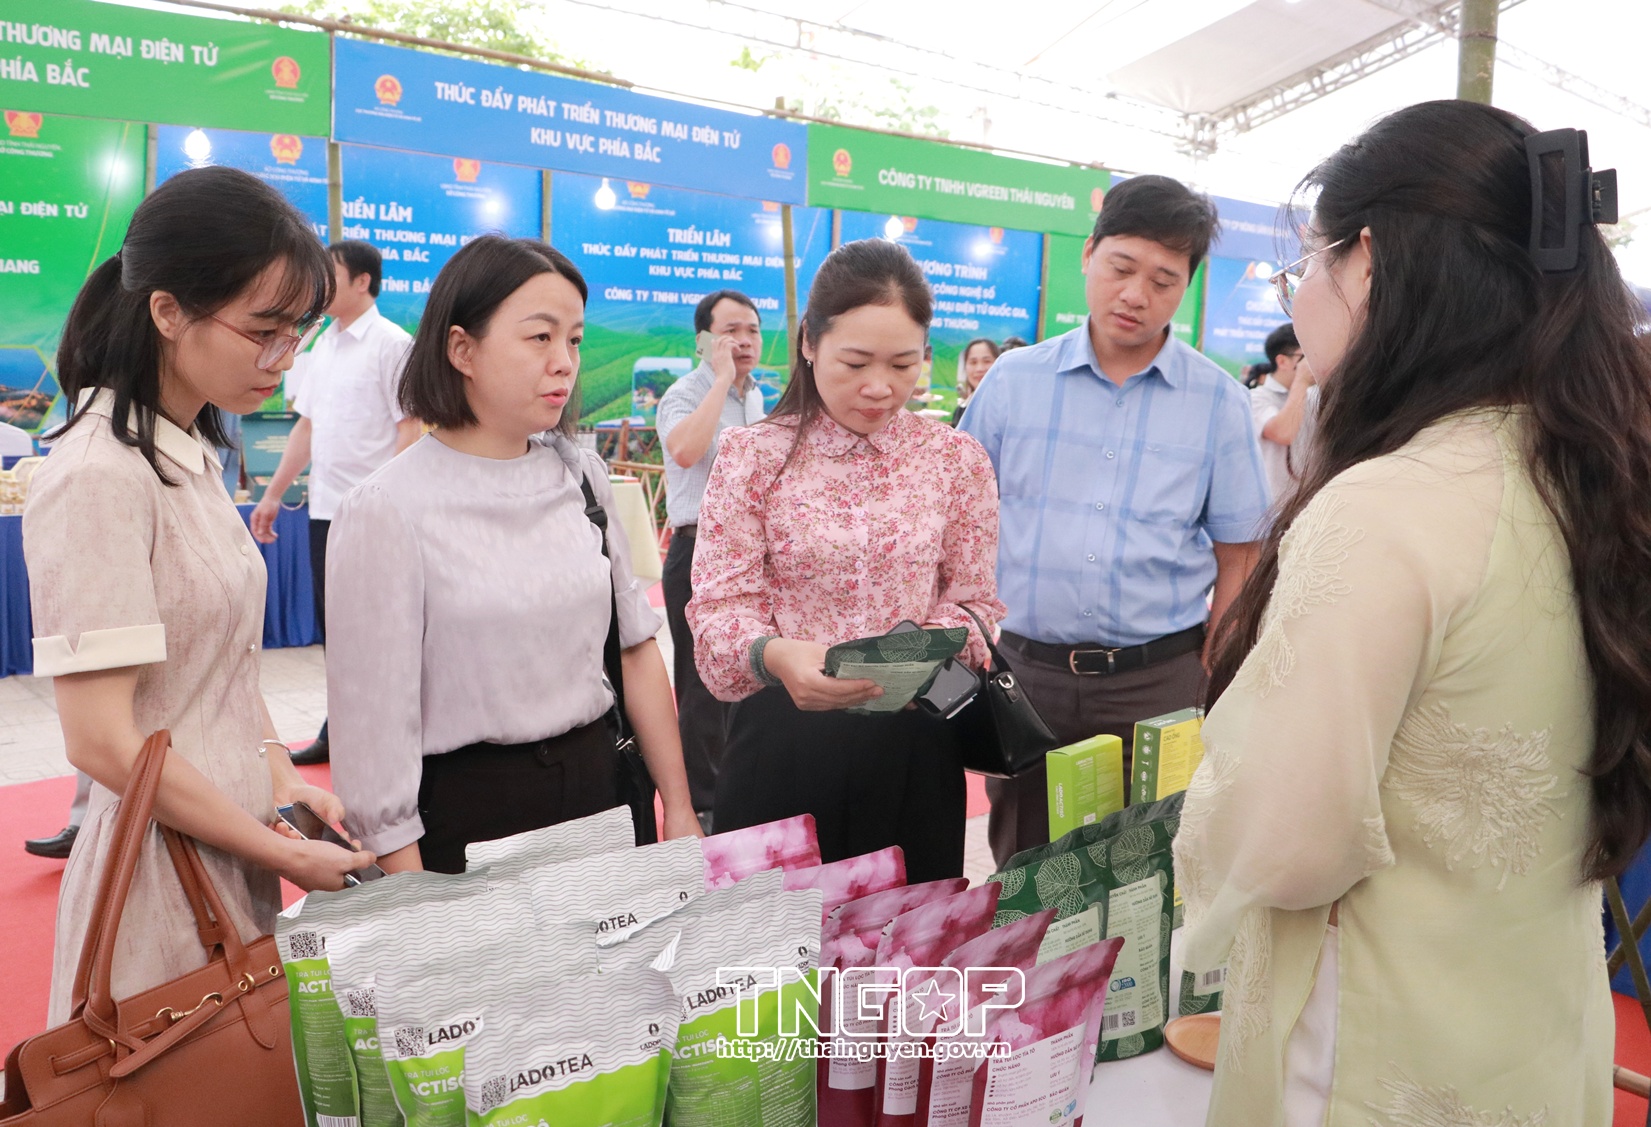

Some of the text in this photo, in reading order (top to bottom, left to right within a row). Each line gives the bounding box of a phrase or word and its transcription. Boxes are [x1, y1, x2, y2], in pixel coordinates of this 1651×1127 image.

[0, 20, 219, 67] THƯƠNG MẠI ĐIỆN TỬ
[0, 56, 90, 88] HÍA BẮC
[434, 82, 741, 150] THÚC ĐẨY PHÁT TRIỂN THƯƠNG MẠI ĐIỆN TỬ
[530, 127, 661, 163] KHU VỰC PHÍA BẮC
[878, 167, 915, 188] CÔNG
[917, 174, 932, 191] TY
[934, 177, 965, 196] TNHH
[967, 181, 1008, 201] VGREEN
[1010, 186, 1033, 204] THÁI
[1034, 189, 1075, 210] NGUYÊN
[20, 200, 58, 218] ĐIỆN
[64, 202, 89, 219] TỬ
[341, 196, 413, 223] RIỂN LÃM
[341, 224, 370, 240] RIỂN
[374, 228, 426, 244] THƯƠNG
[430, 233, 456, 247] MẠI
[667, 225, 731, 247] TRIỂN LÃM
[403, 247, 430, 263] BẮC
[582, 242, 611, 256] THÚC
[614, 244, 637, 257] ĐẨY
[640, 247, 668, 260] PHÁT
[671, 249, 699, 262] TRIỂN
[702, 253, 740, 266] THƯƠNG
[742, 256, 763, 268] MẠI
[649, 265, 743, 282] KHU VỰC PHÍA BẮC
[916, 259, 988, 280] ƯƠNG TRÌNH
[381, 276, 410, 292] TỈNH
[604, 286, 632, 301] CÔNG
[635, 290, 650, 302] TY
[652, 291, 679, 303] TNHH
[933, 282, 996, 300] CÔNG NGHỆ SỐ
[931, 318, 942, 328] NG
[595, 913, 638, 933] OTEA
[428, 1017, 481, 1045] LADO
